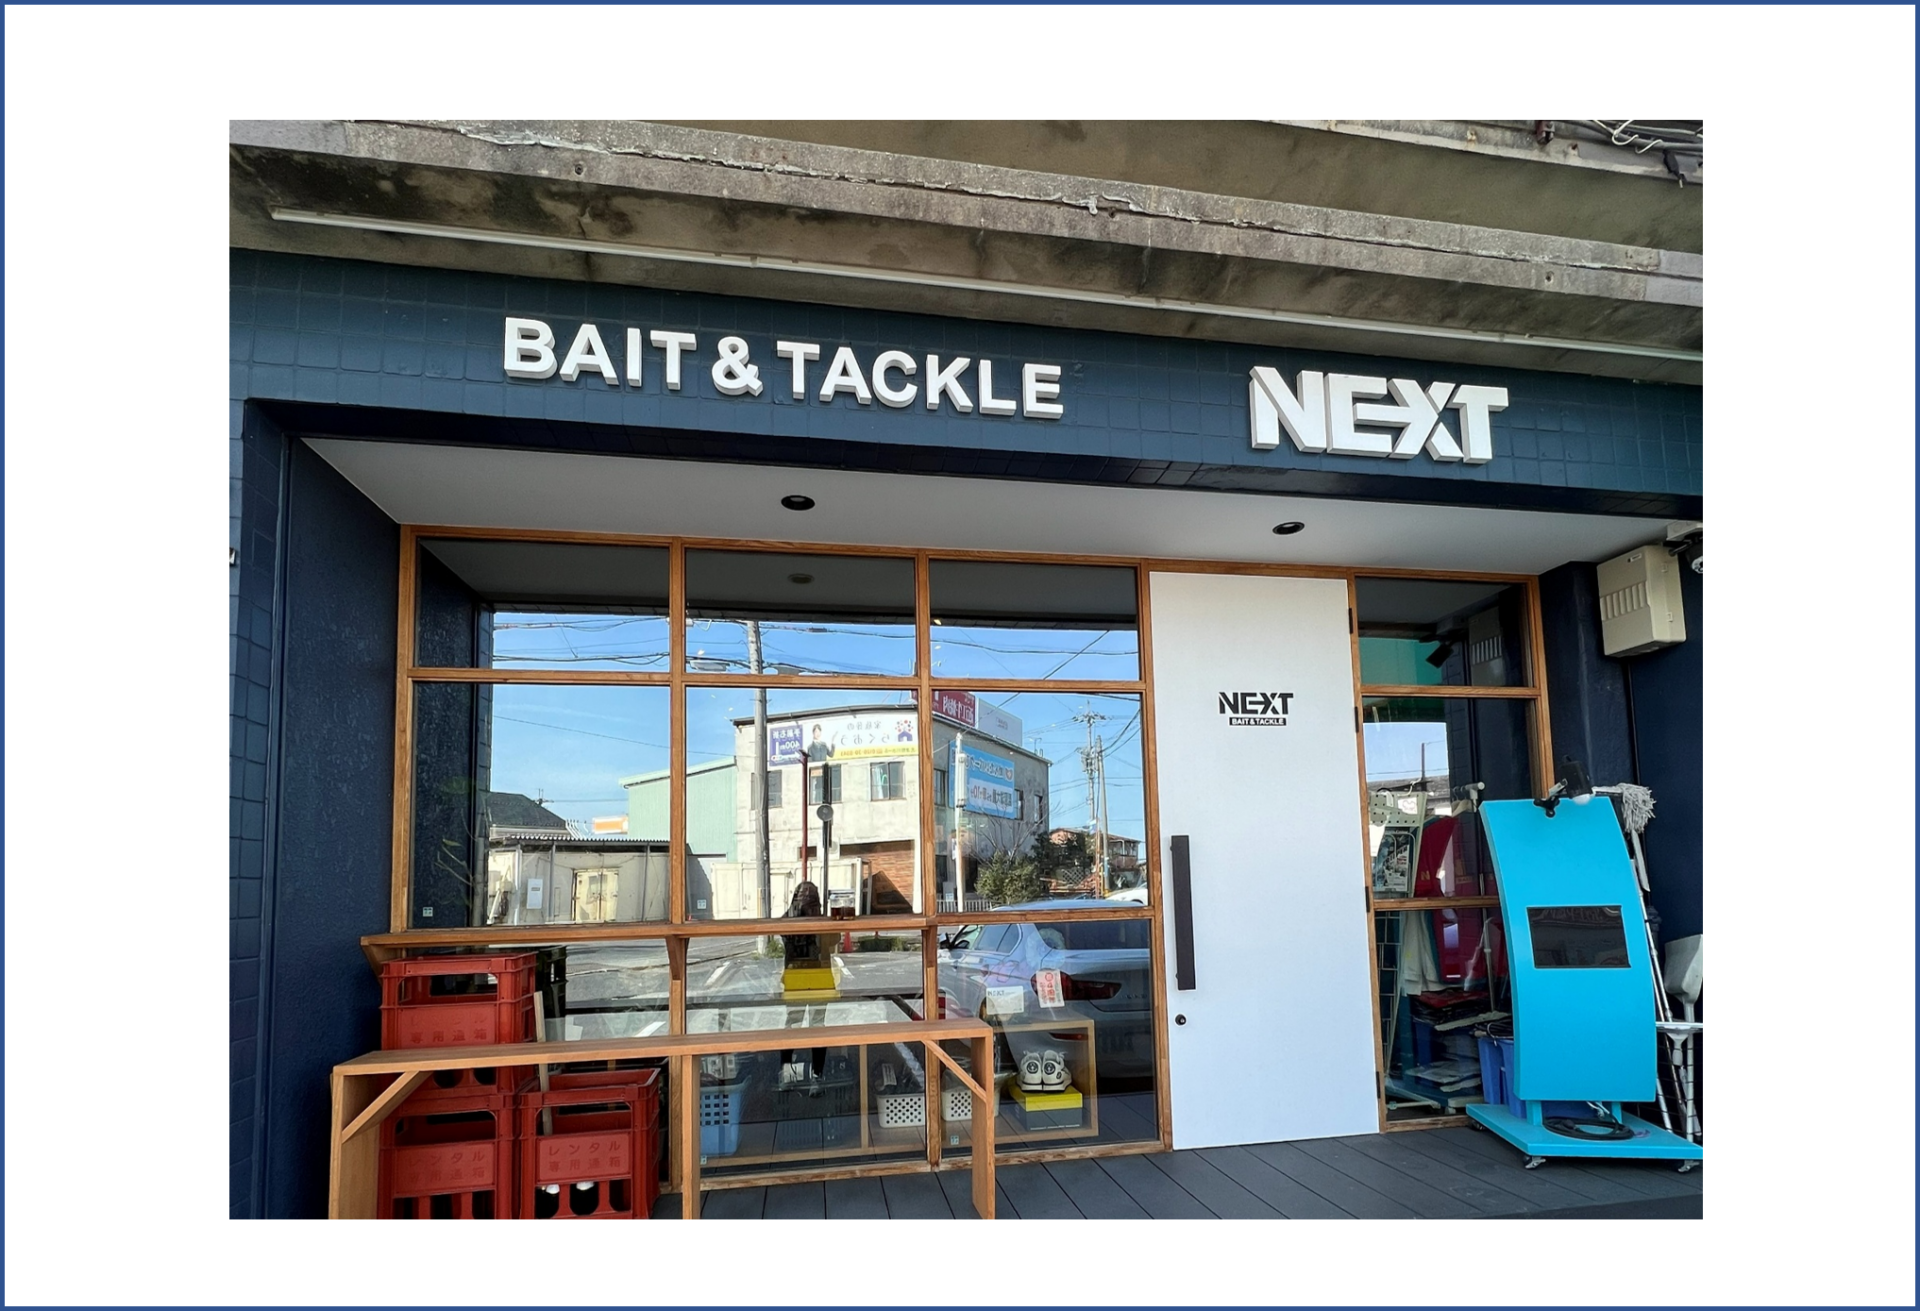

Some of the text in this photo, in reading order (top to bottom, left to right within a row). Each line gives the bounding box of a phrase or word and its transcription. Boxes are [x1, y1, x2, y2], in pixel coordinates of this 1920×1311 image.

[504, 317, 1064, 419] BAIT & TACKLE
[1249, 366, 1509, 464] NEXT
[1218, 691, 1294, 715] NEXT
[549, 1140, 621, 1157] レンタル
